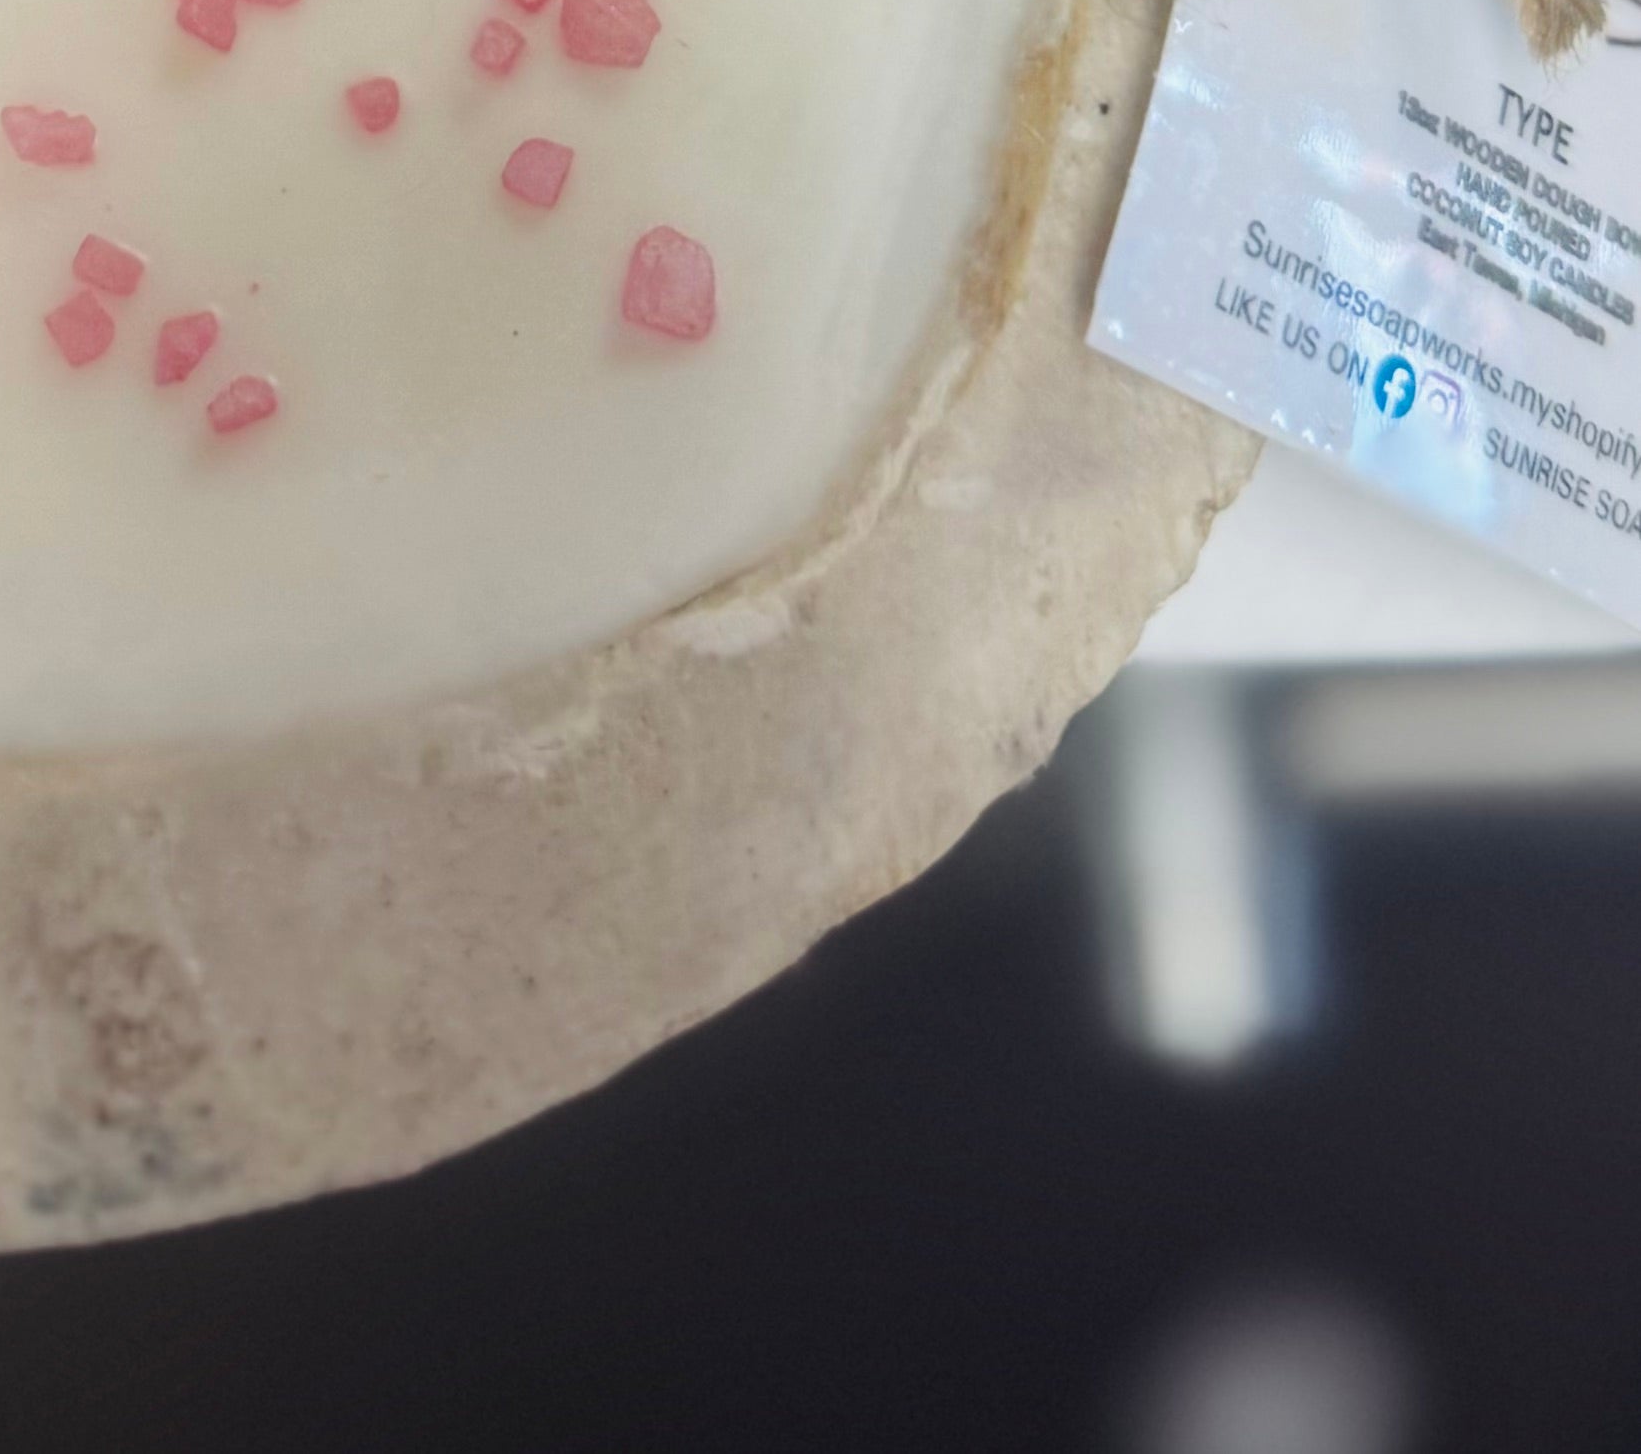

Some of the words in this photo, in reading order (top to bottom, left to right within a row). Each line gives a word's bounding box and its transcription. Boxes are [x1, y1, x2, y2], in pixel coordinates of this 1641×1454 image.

[1443, 116, 1531, 190] WOODEN
[1533, 172, 1602, 233] DOUGH
[1498, 82, 1575, 166] TYPE
[1407, 171, 1505, 247] COCONUT
[1505, 229, 1548, 272] SOY
[1548, 256, 1635, 326] CANDLES
[1456, 161, 1511, 213] HAND
[1512, 198, 1592, 262] POURED
[1416, 213, 1459, 261] East
[1527, 278, 1607, 346] Michigan
[1214, 277, 1276, 337] LIKE
[1280, 314, 1322, 360] US
[1326, 340, 1372, 389] ON
[1483, 426, 1591, 510] SUNRISE
